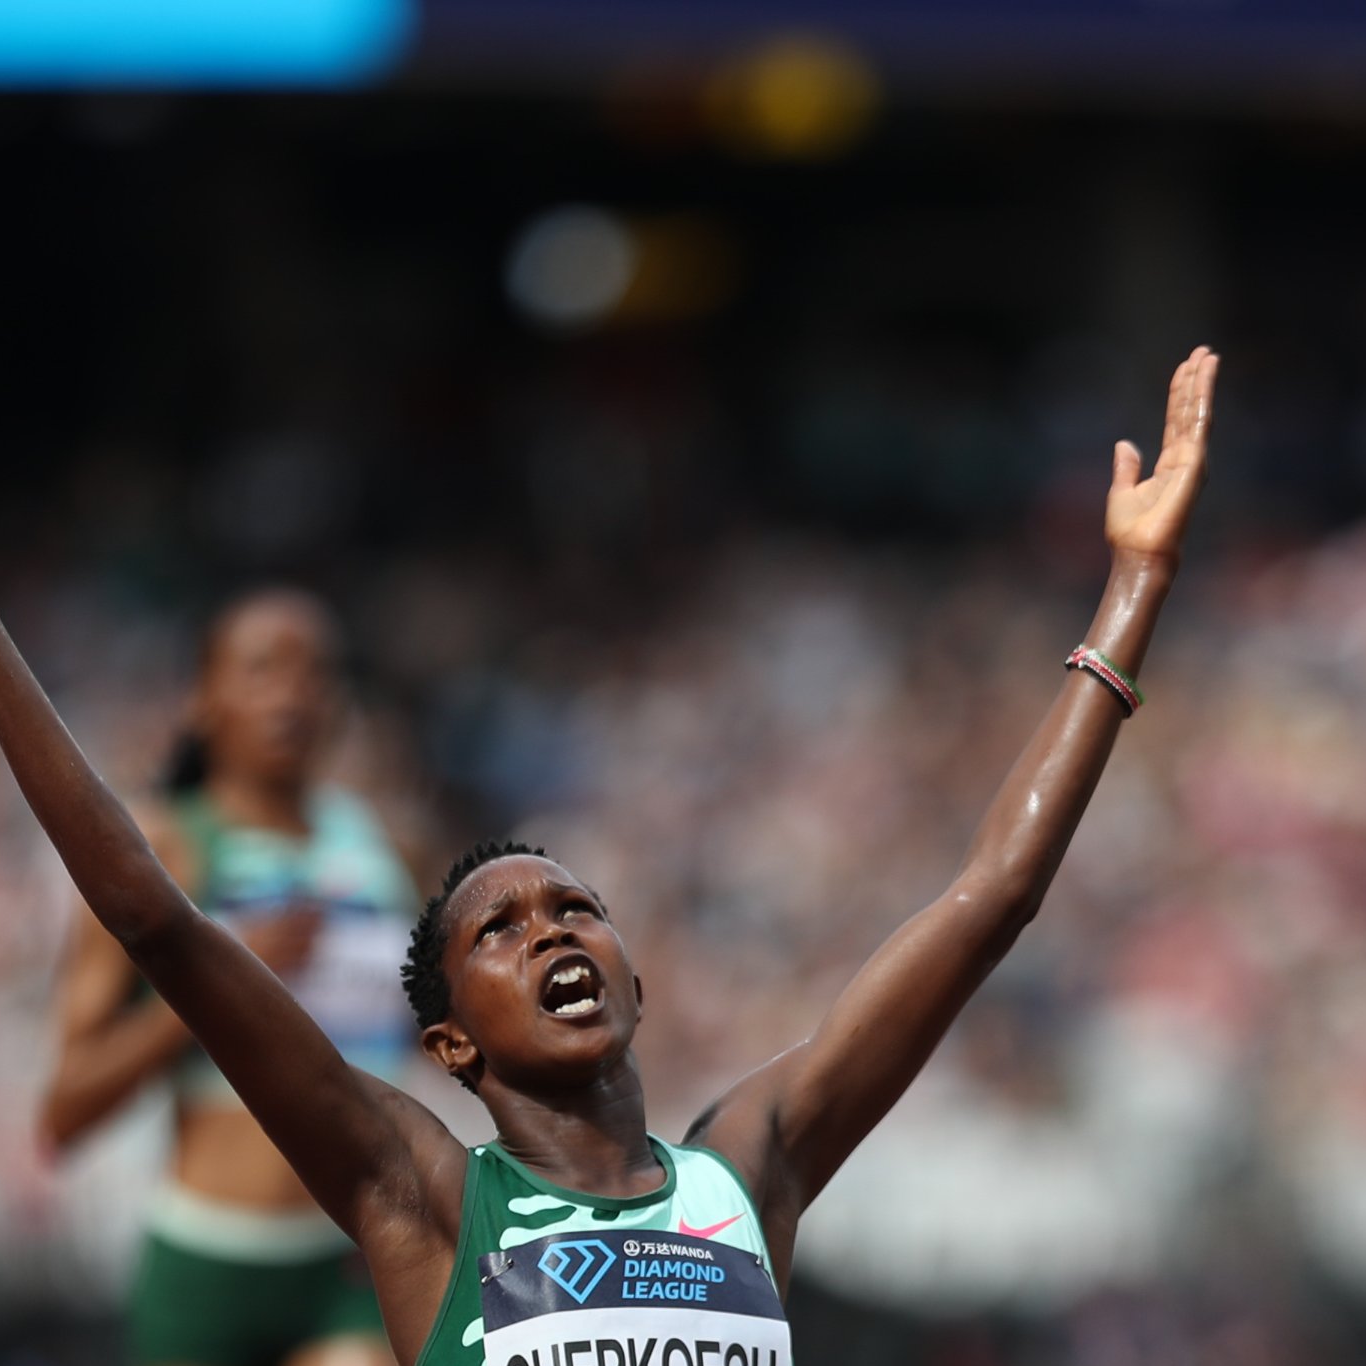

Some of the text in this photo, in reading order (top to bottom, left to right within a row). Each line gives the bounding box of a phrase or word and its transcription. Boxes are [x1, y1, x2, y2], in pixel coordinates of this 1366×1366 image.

[669, 1245, 714, 1260] WANDA
[624, 1260, 725, 1283] DIAMOND
[622, 1282, 708, 1302] LEAGUE
